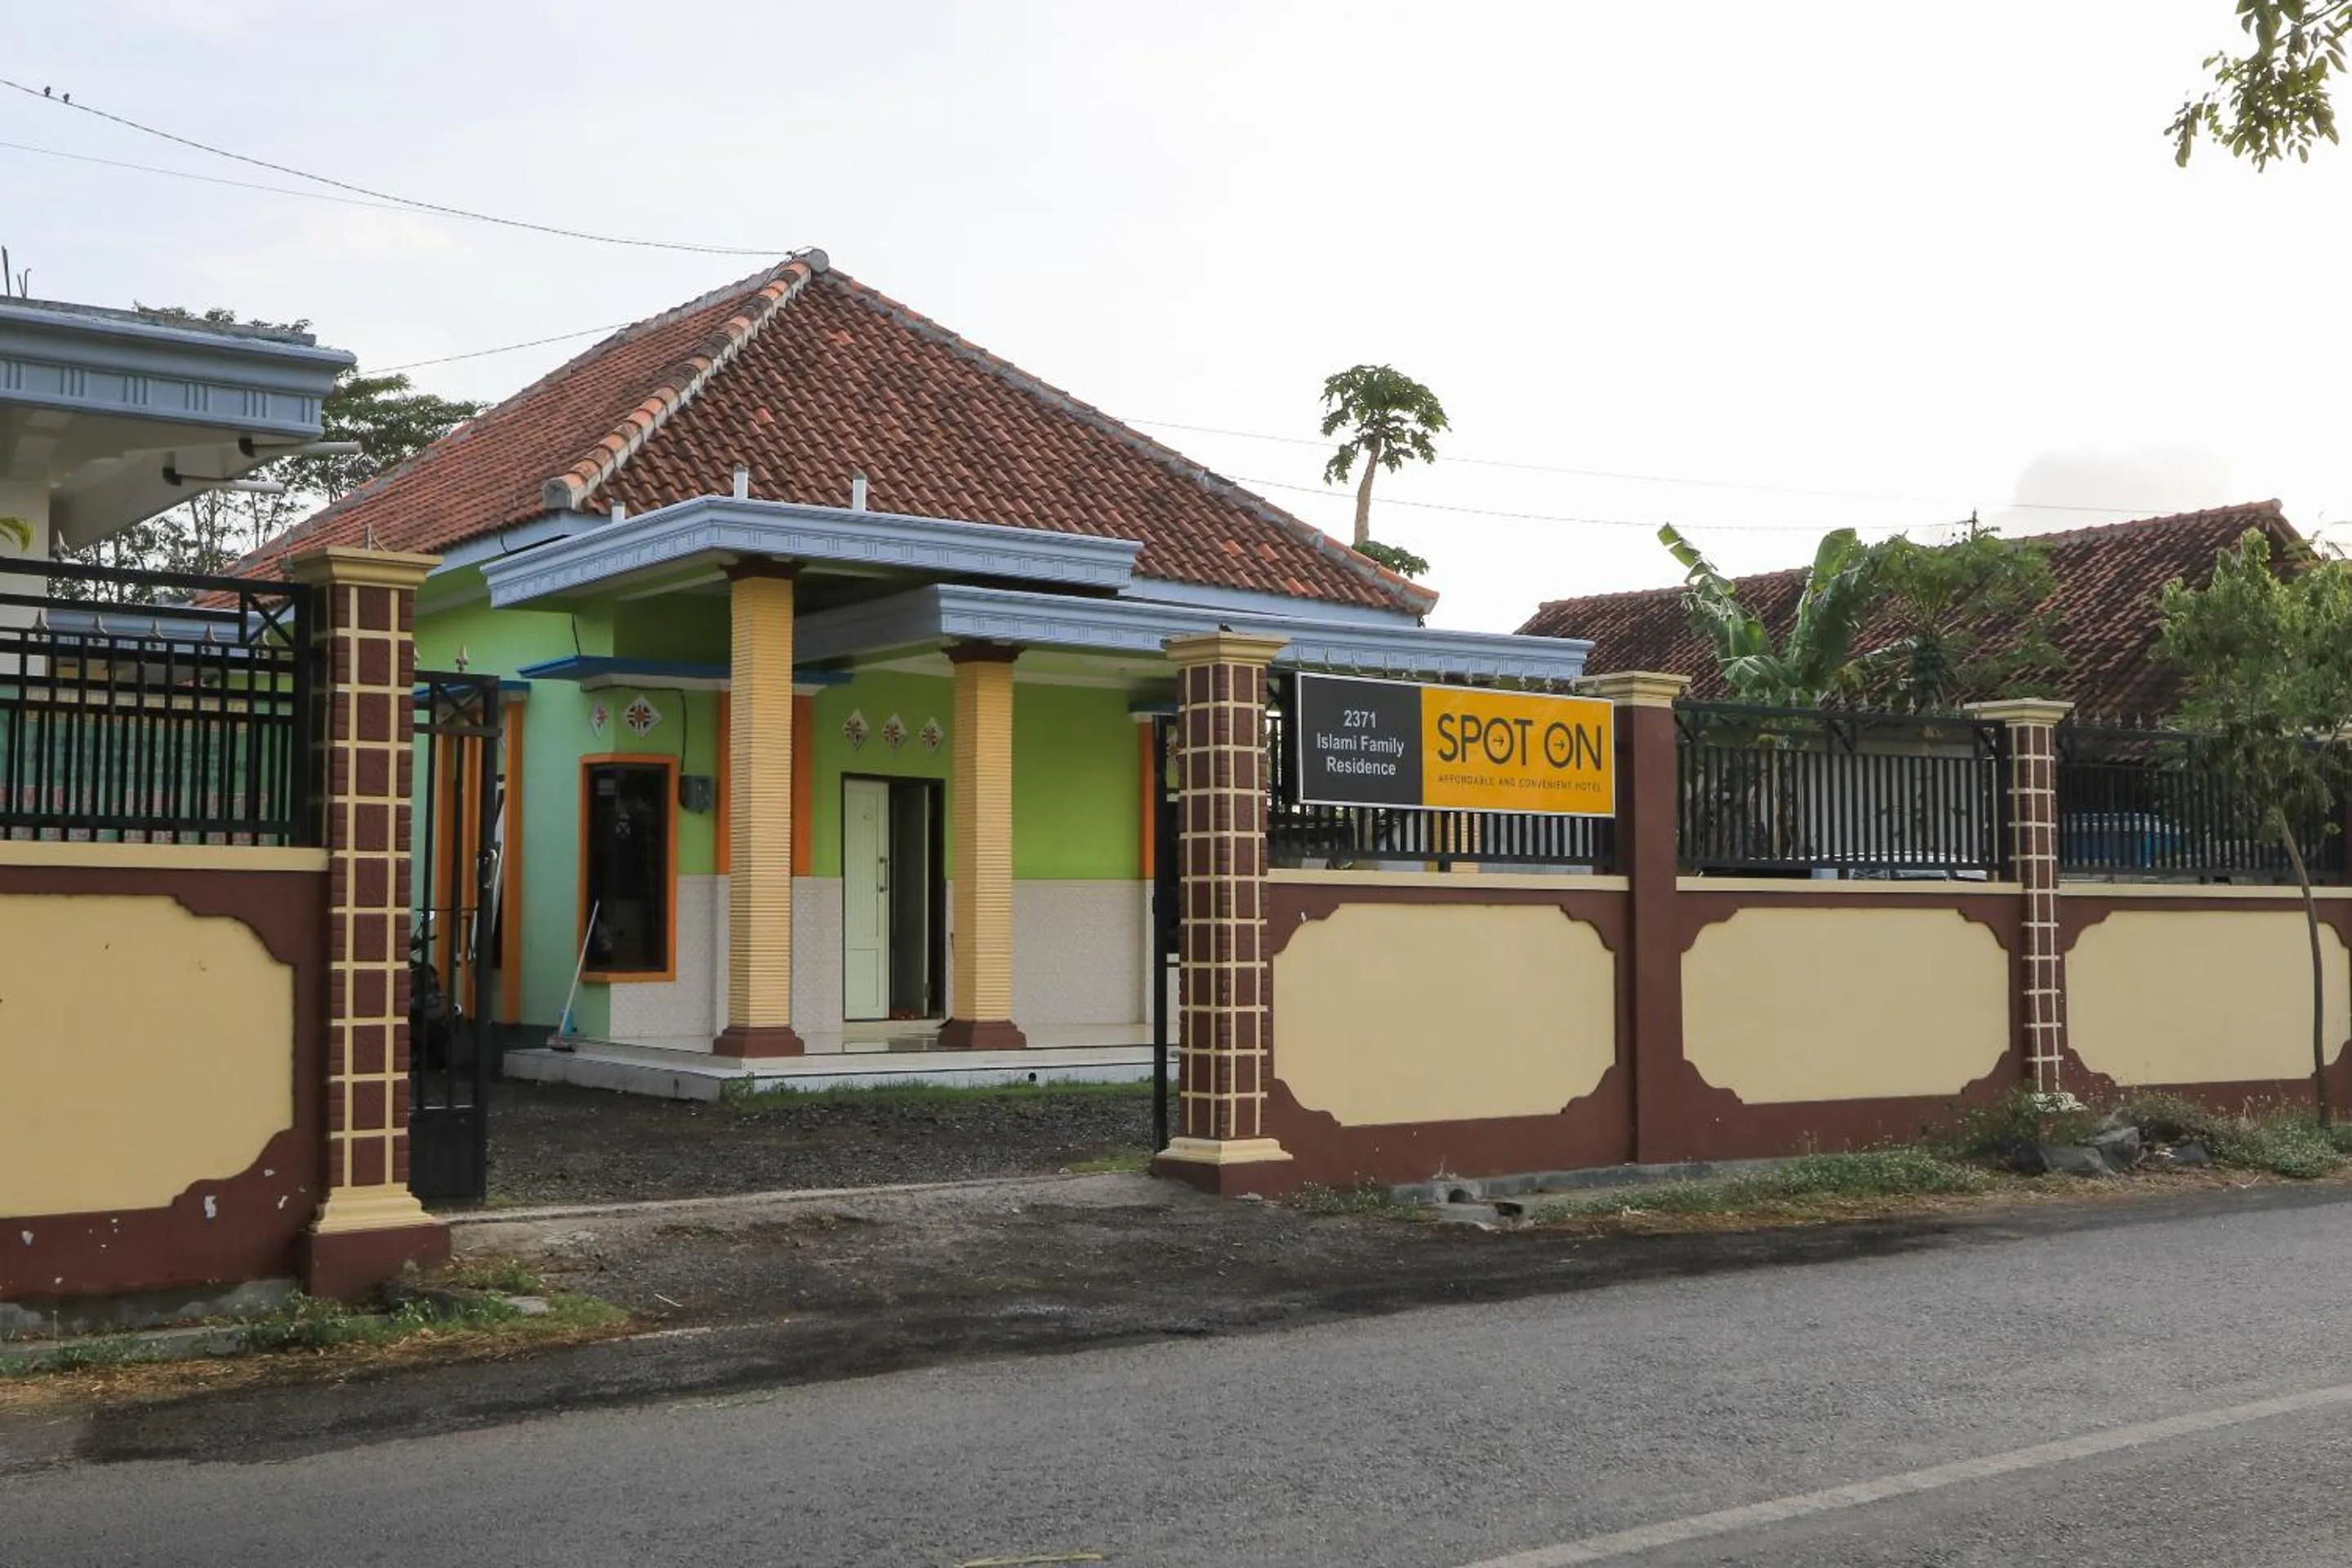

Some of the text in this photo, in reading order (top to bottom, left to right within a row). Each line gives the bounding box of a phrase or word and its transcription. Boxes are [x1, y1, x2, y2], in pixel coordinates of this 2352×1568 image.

[1343, 710, 1376, 728] 2371
[1316, 732, 1404, 758] Islami Family
[1437, 713, 1602, 772] SPOT ON
[1326, 755, 1396, 775] Residence
[1438, 775, 1602, 792] AFFORDABLE AND CONVENIENT HOTEL
